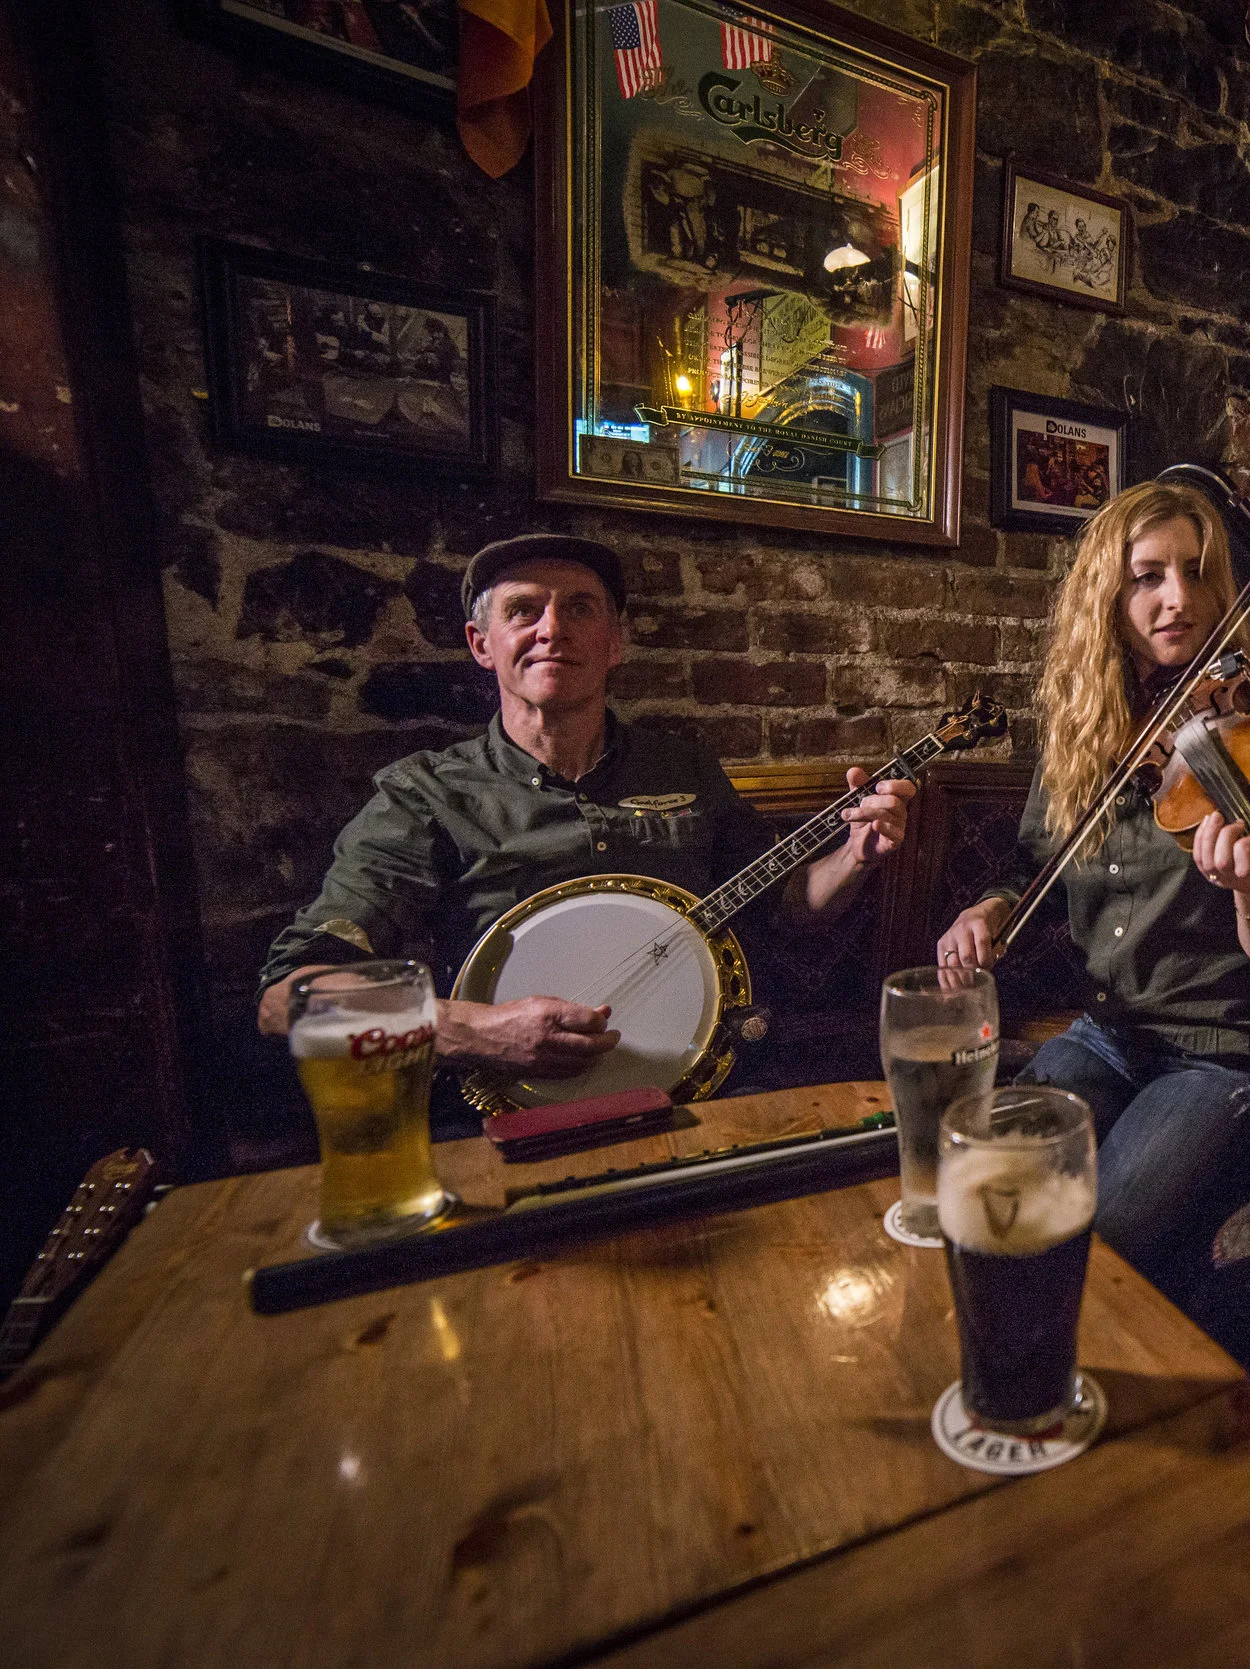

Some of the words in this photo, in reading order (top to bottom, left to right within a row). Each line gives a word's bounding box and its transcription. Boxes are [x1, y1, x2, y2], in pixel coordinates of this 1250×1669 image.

[698, 70, 843, 161] Carlsberg
[689, 414, 744, 430] APPOINTMENT
[758, 426, 774, 434] THE
[775, 429, 799, 438] ROYAL
[801, 433, 828, 444] DANISH
[829, 437, 853, 447] COURT
[1046, 419, 1087, 439] DOLANS
